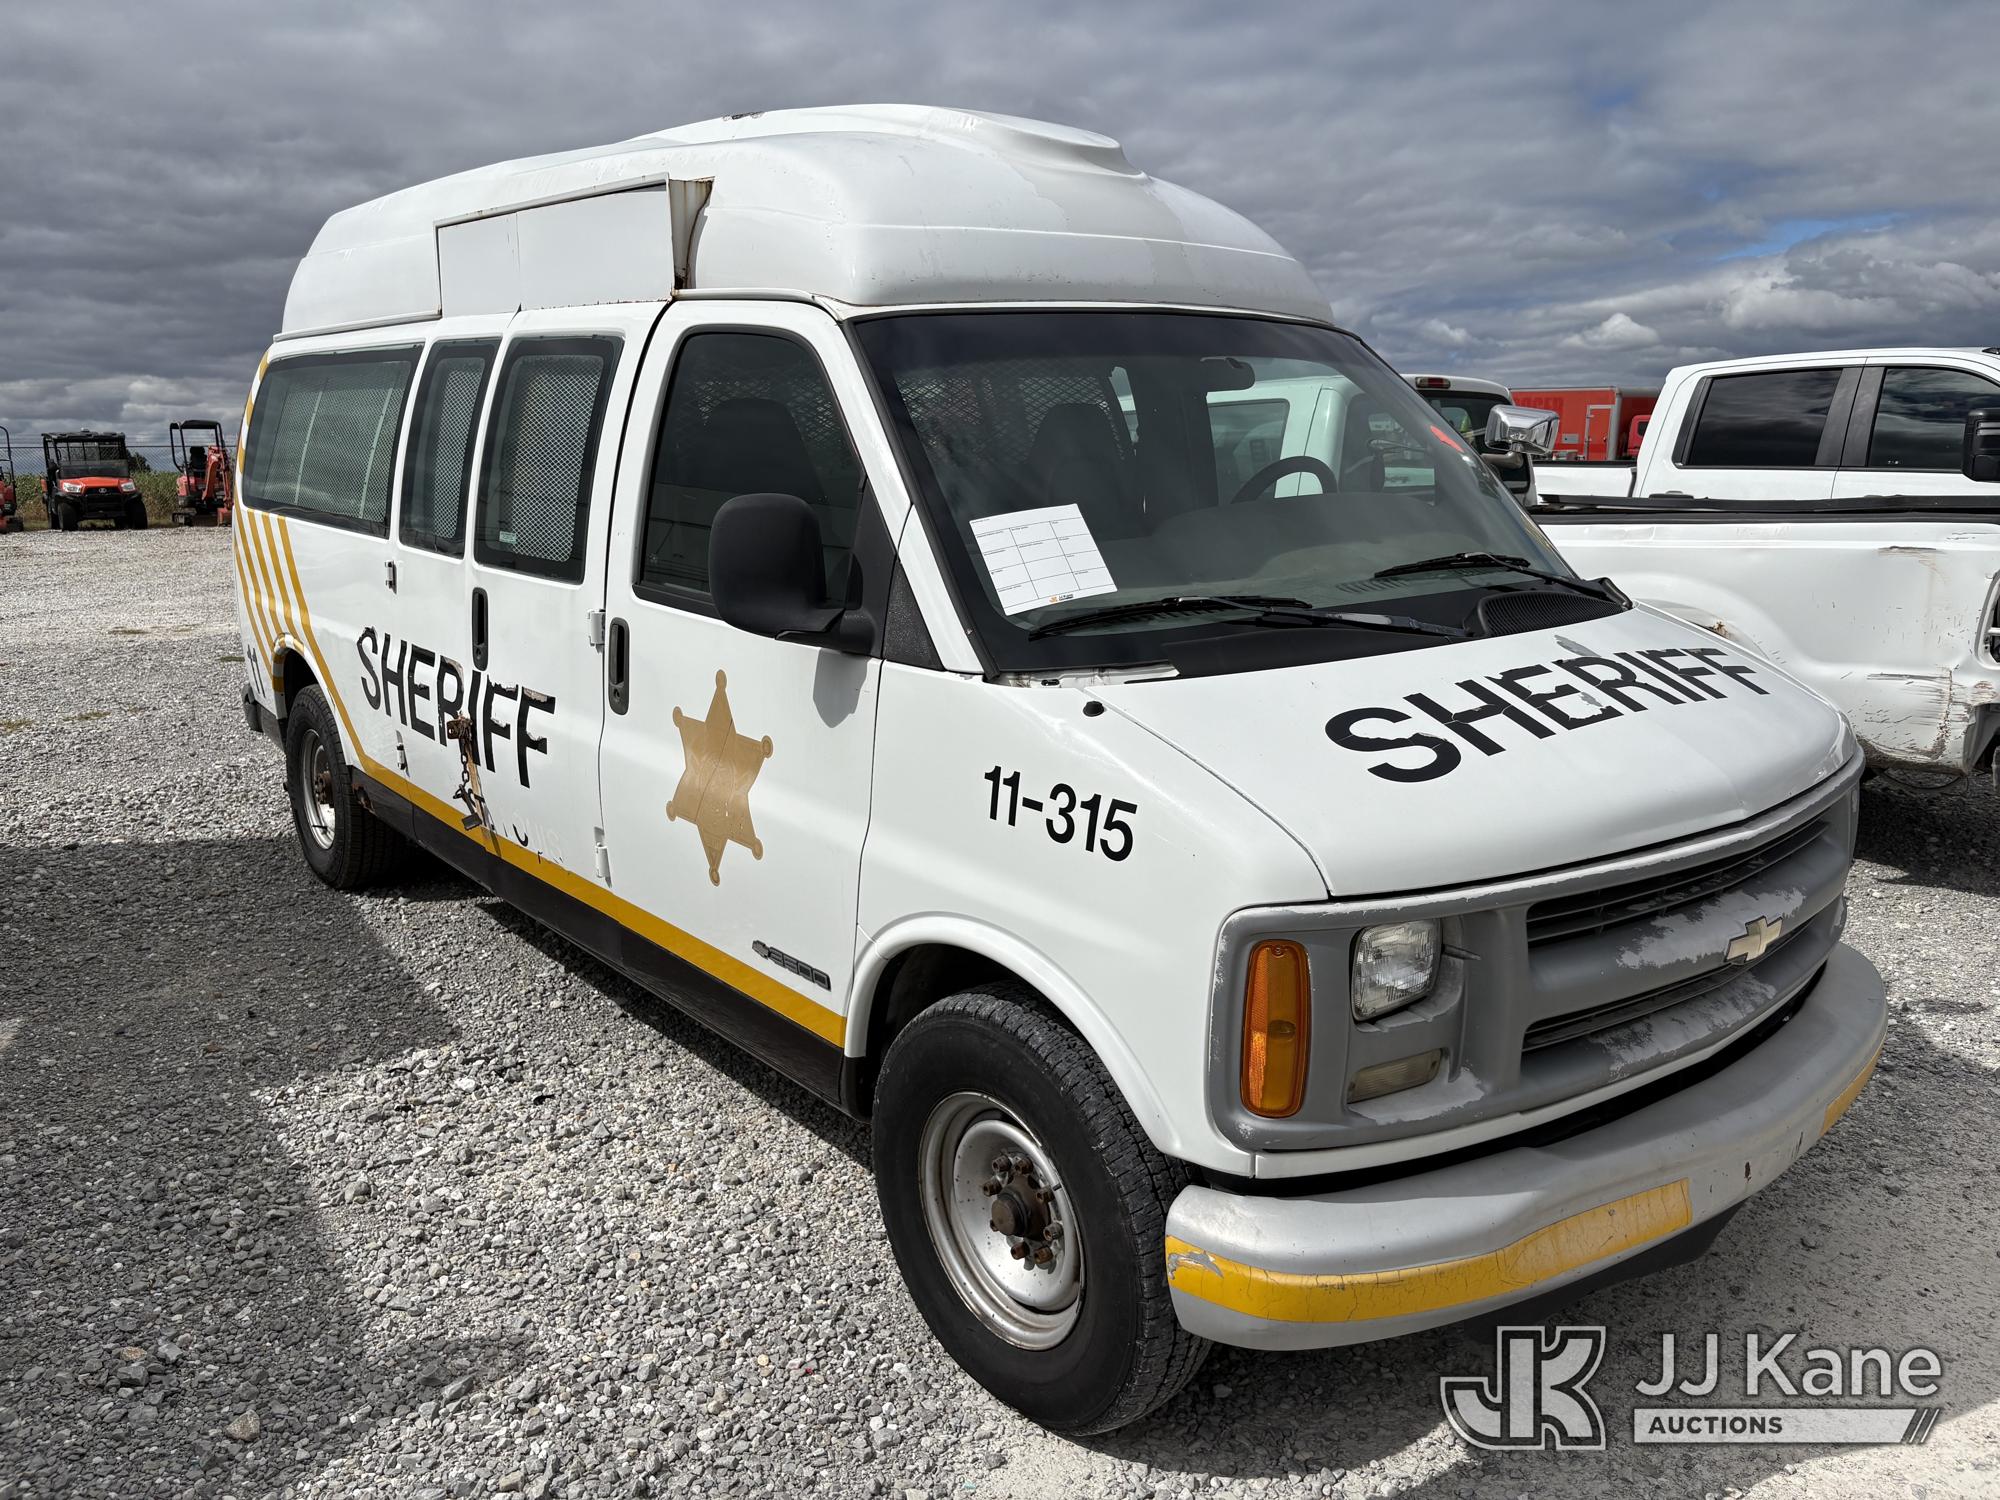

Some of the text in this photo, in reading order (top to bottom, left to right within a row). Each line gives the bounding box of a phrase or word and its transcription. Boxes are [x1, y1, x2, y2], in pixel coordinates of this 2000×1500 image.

[356, 626, 556, 788] SHERIFF
[1324, 647, 1771, 783] SHERIFF
[984, 765, 1138, 862] 11-315
